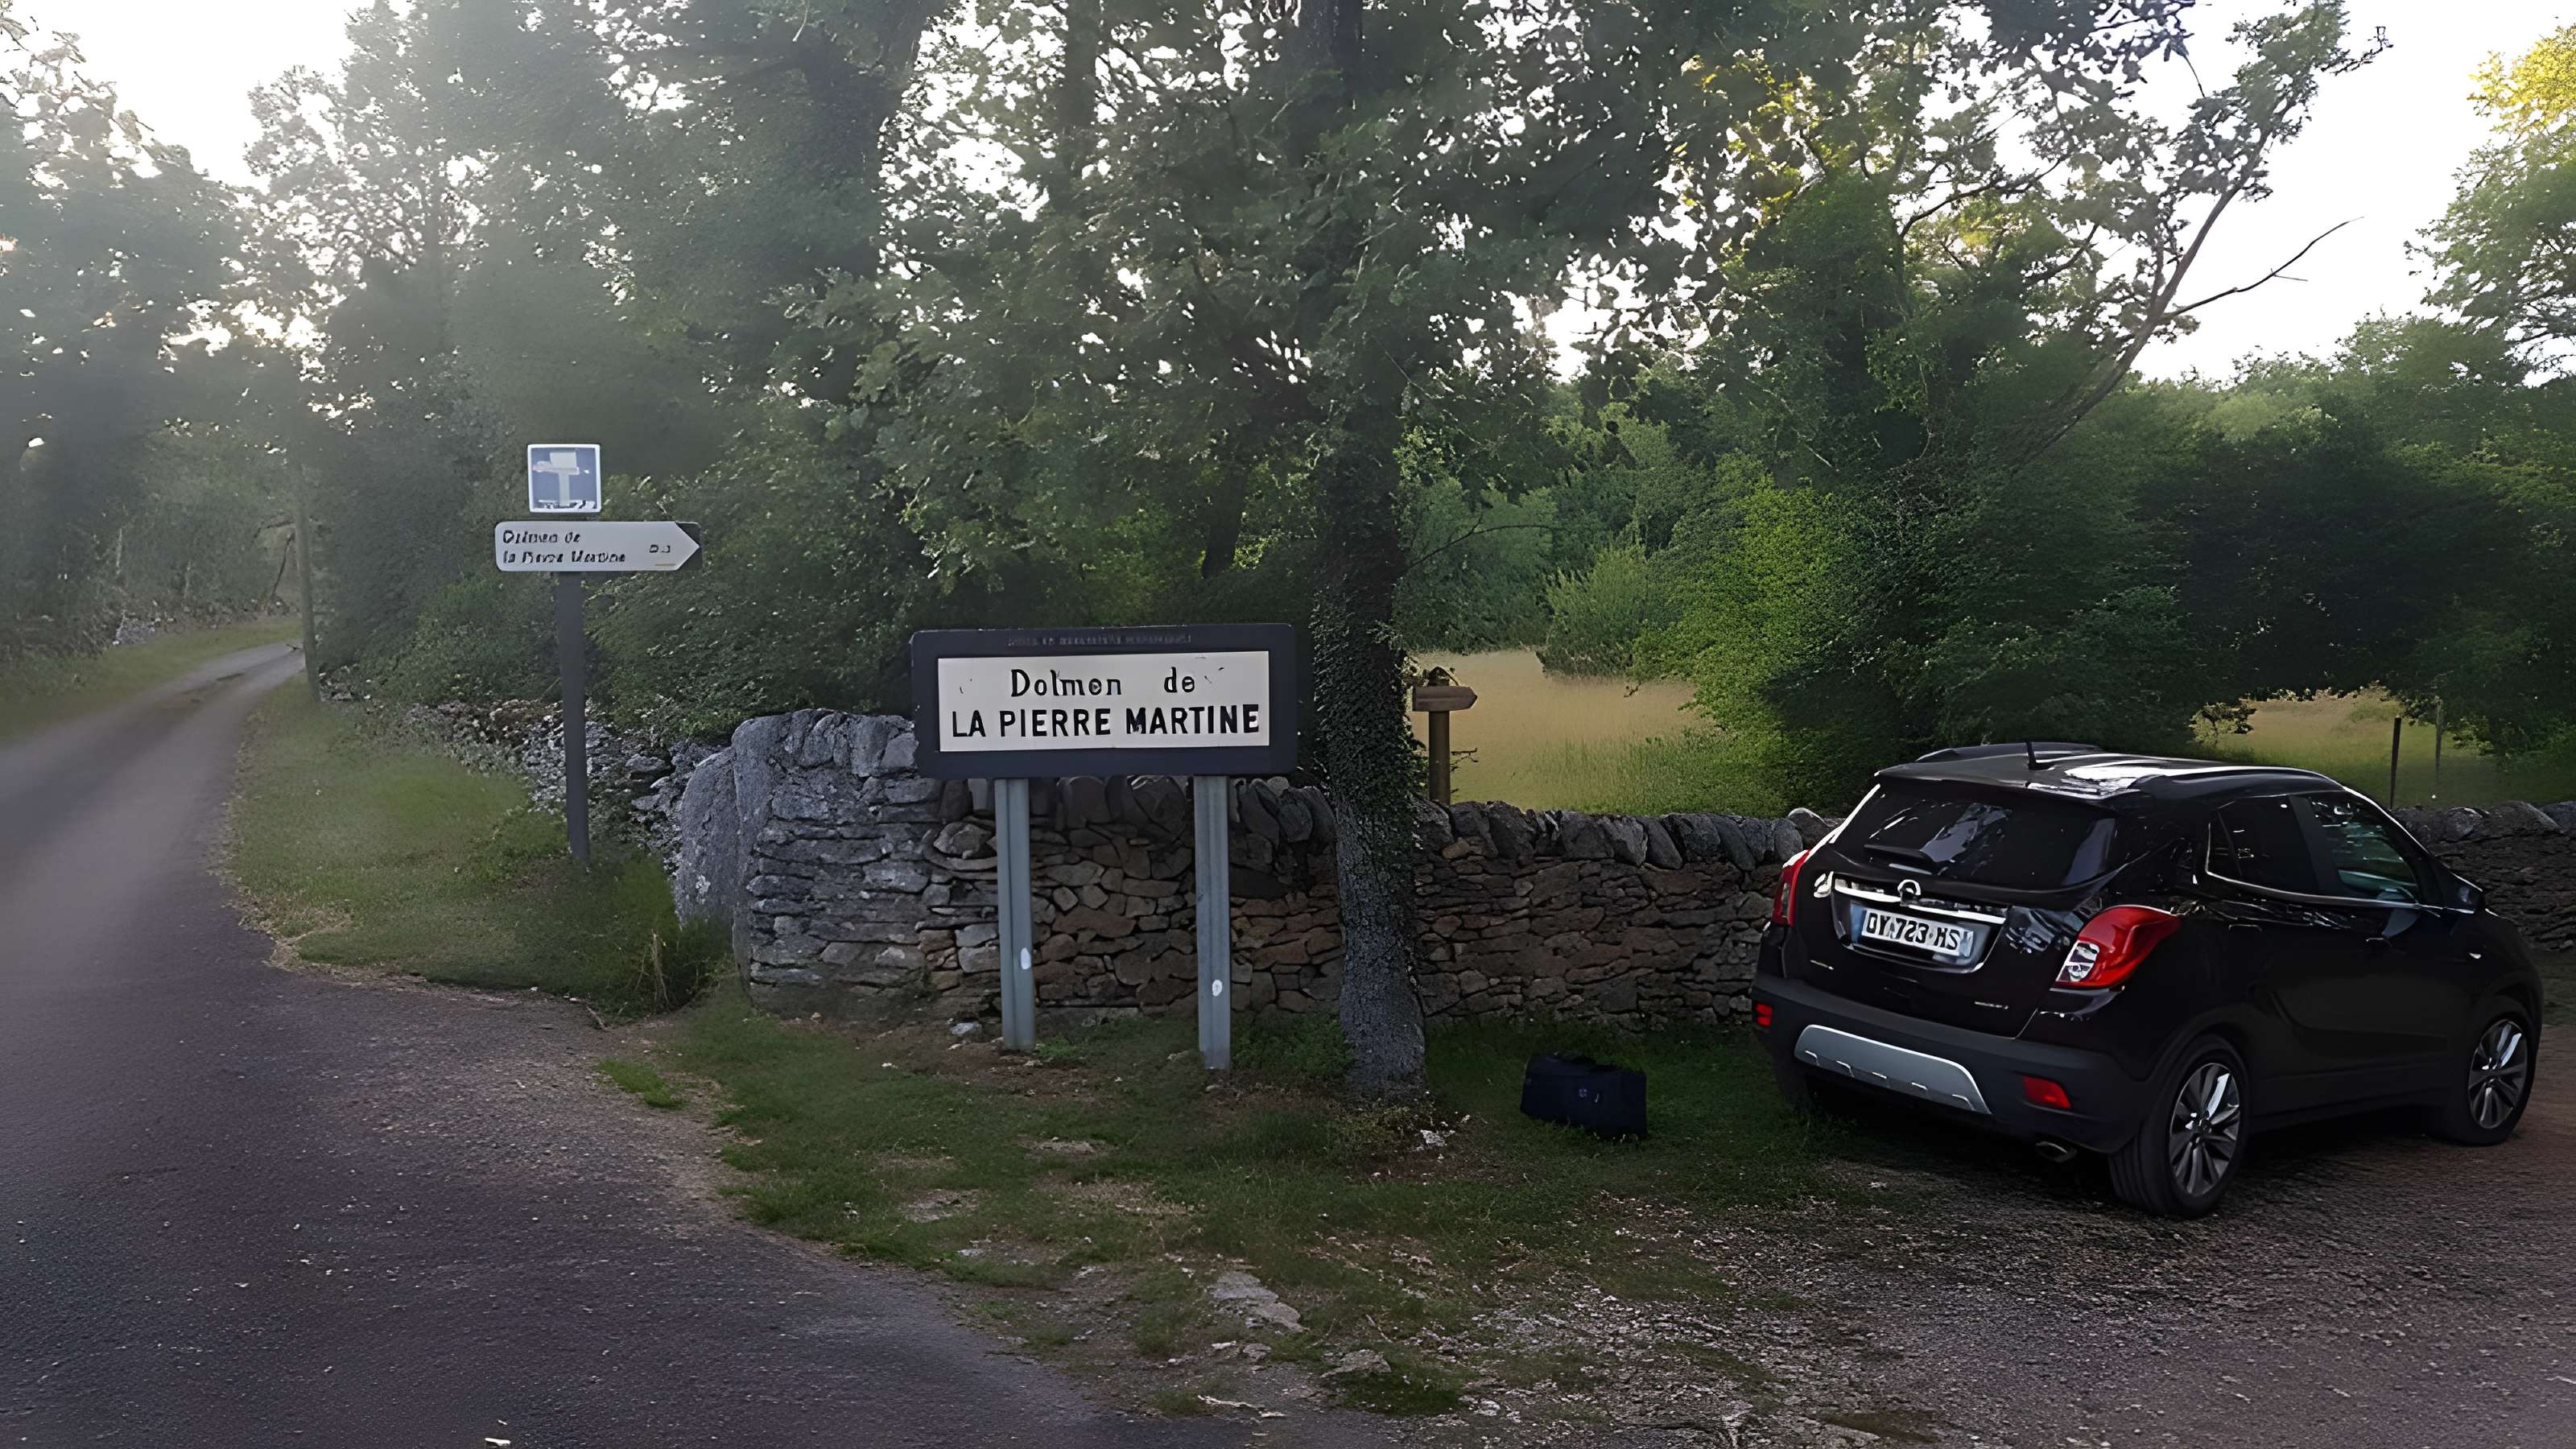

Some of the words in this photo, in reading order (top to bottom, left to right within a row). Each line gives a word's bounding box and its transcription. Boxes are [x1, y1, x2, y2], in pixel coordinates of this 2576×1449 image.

[1010, 668, 1122, 698] Dolmen
[1163, 666, 1195, 693] de
[952, 709, 986, 737] LA
[999, 708, 1111, 737] PIERRE
[1125, 704, 1260, 735] MARTINE
